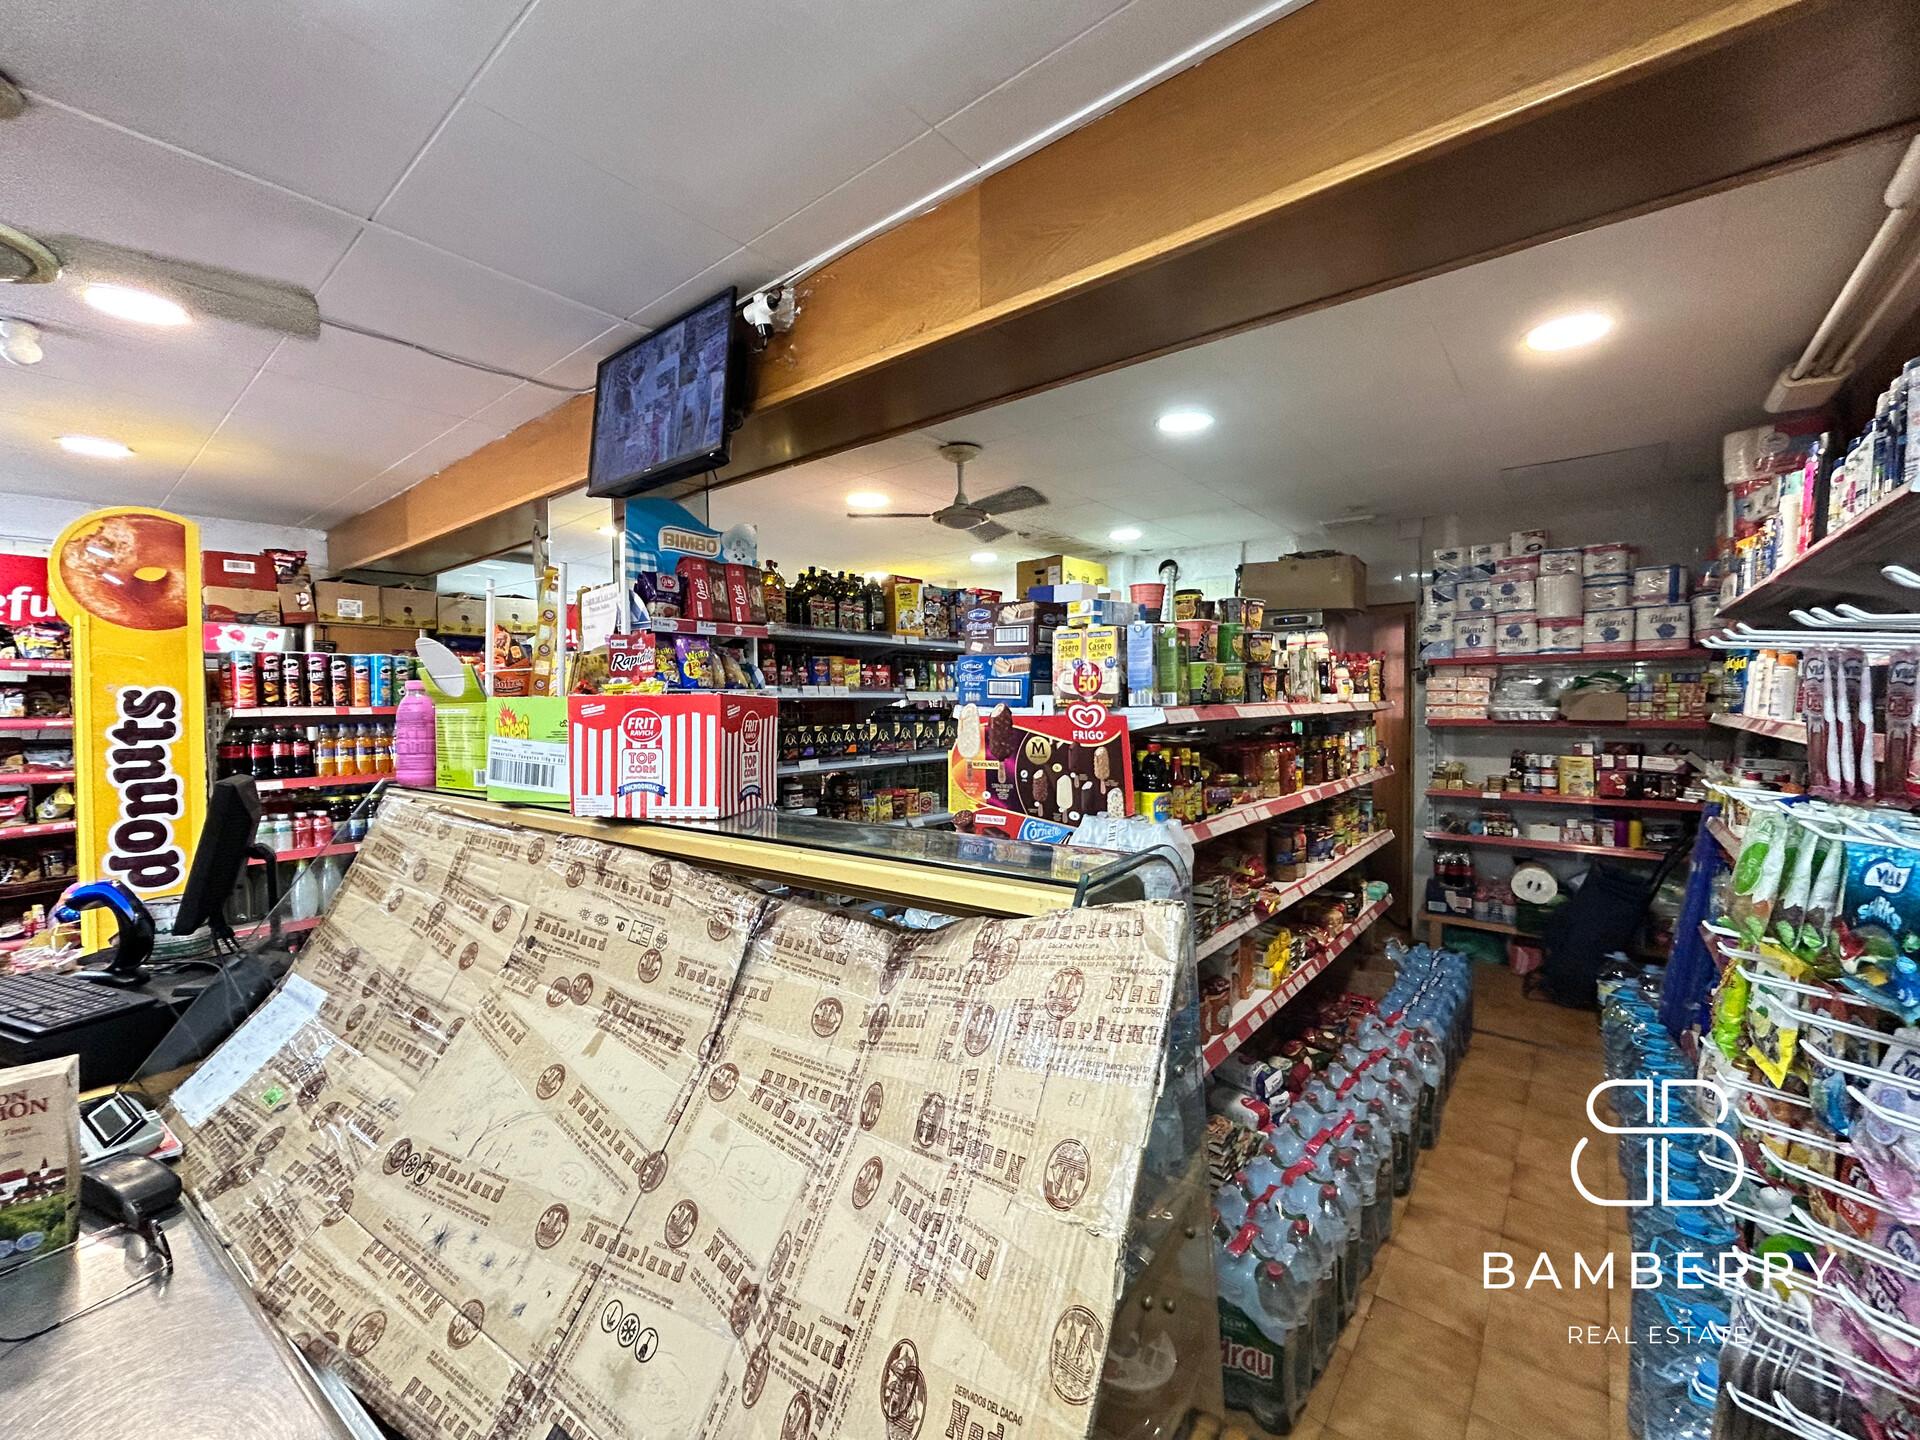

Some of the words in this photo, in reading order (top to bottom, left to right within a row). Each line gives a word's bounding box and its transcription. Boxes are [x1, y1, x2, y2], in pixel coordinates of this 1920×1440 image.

[662, 532, 717, 554] BIMBO
[1088, 642, 1113, 651] Casero
[627, 717, 658, 729] FRIT
[743, 719, 759, 733] FRIT
[629, 729, 655, 737] RAVICH
[1072, 730, 1104, 741] FRIGO
[1031, 741, 1046, 755] M
[628, 752, 657, 764] TOP
[743, 755, 757, 768] TOP
[628, 764, 657, 774] CORN
[108, 690, 181, 888] donuts
[1023, 820, 1062, 841] Cornetto
[580, 1221, 688, 1284] Nederland
[954, 1383, 987, 1409] DERIVADOS
[987, 1400, 1000, 1416] DEL
[1000, 1406, 1024, 1427] CACAO
